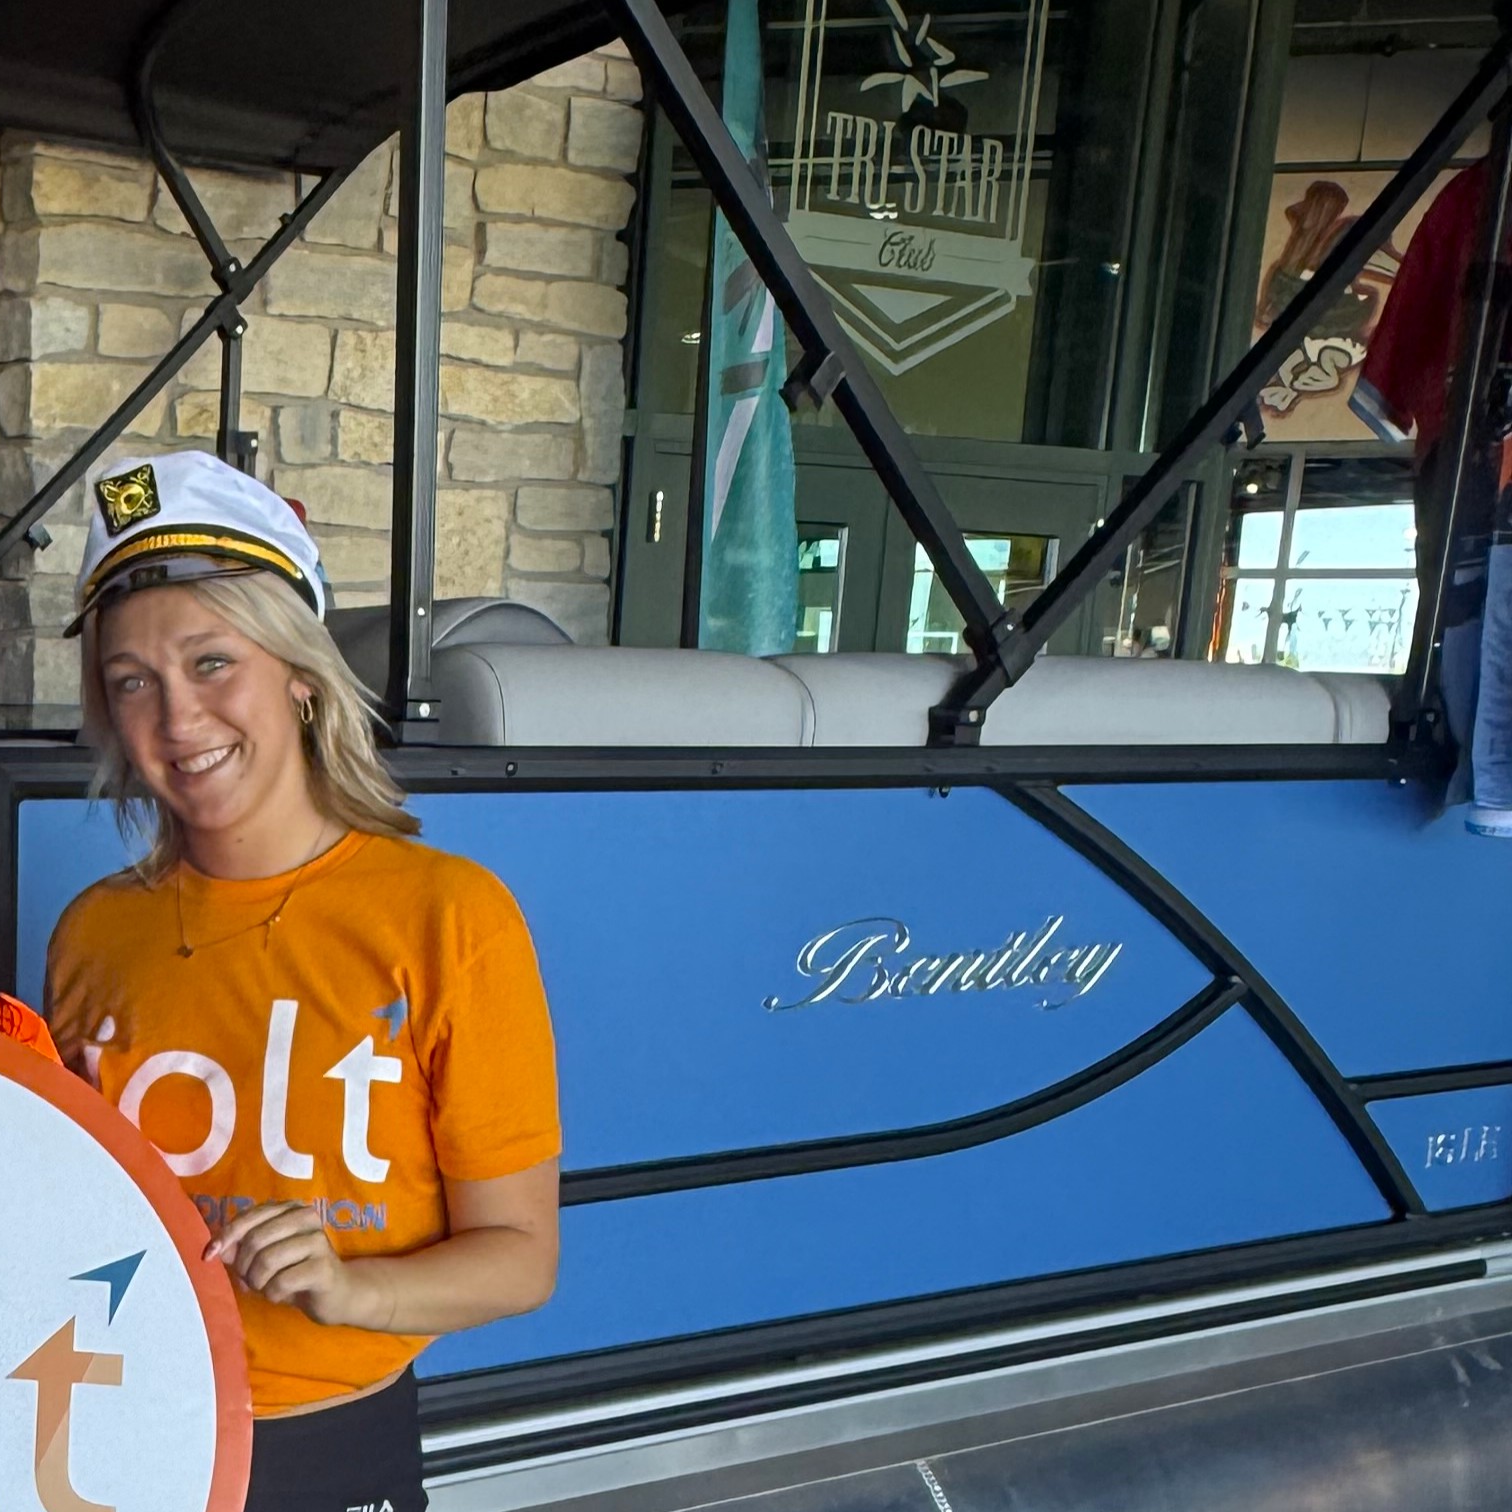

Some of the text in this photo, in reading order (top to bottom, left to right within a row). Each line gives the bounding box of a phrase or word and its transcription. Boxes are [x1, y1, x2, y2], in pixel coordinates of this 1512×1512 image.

[826, 111, 1004, 224] TRI STAR
[761, 915, 1123, 1011] Bentley
